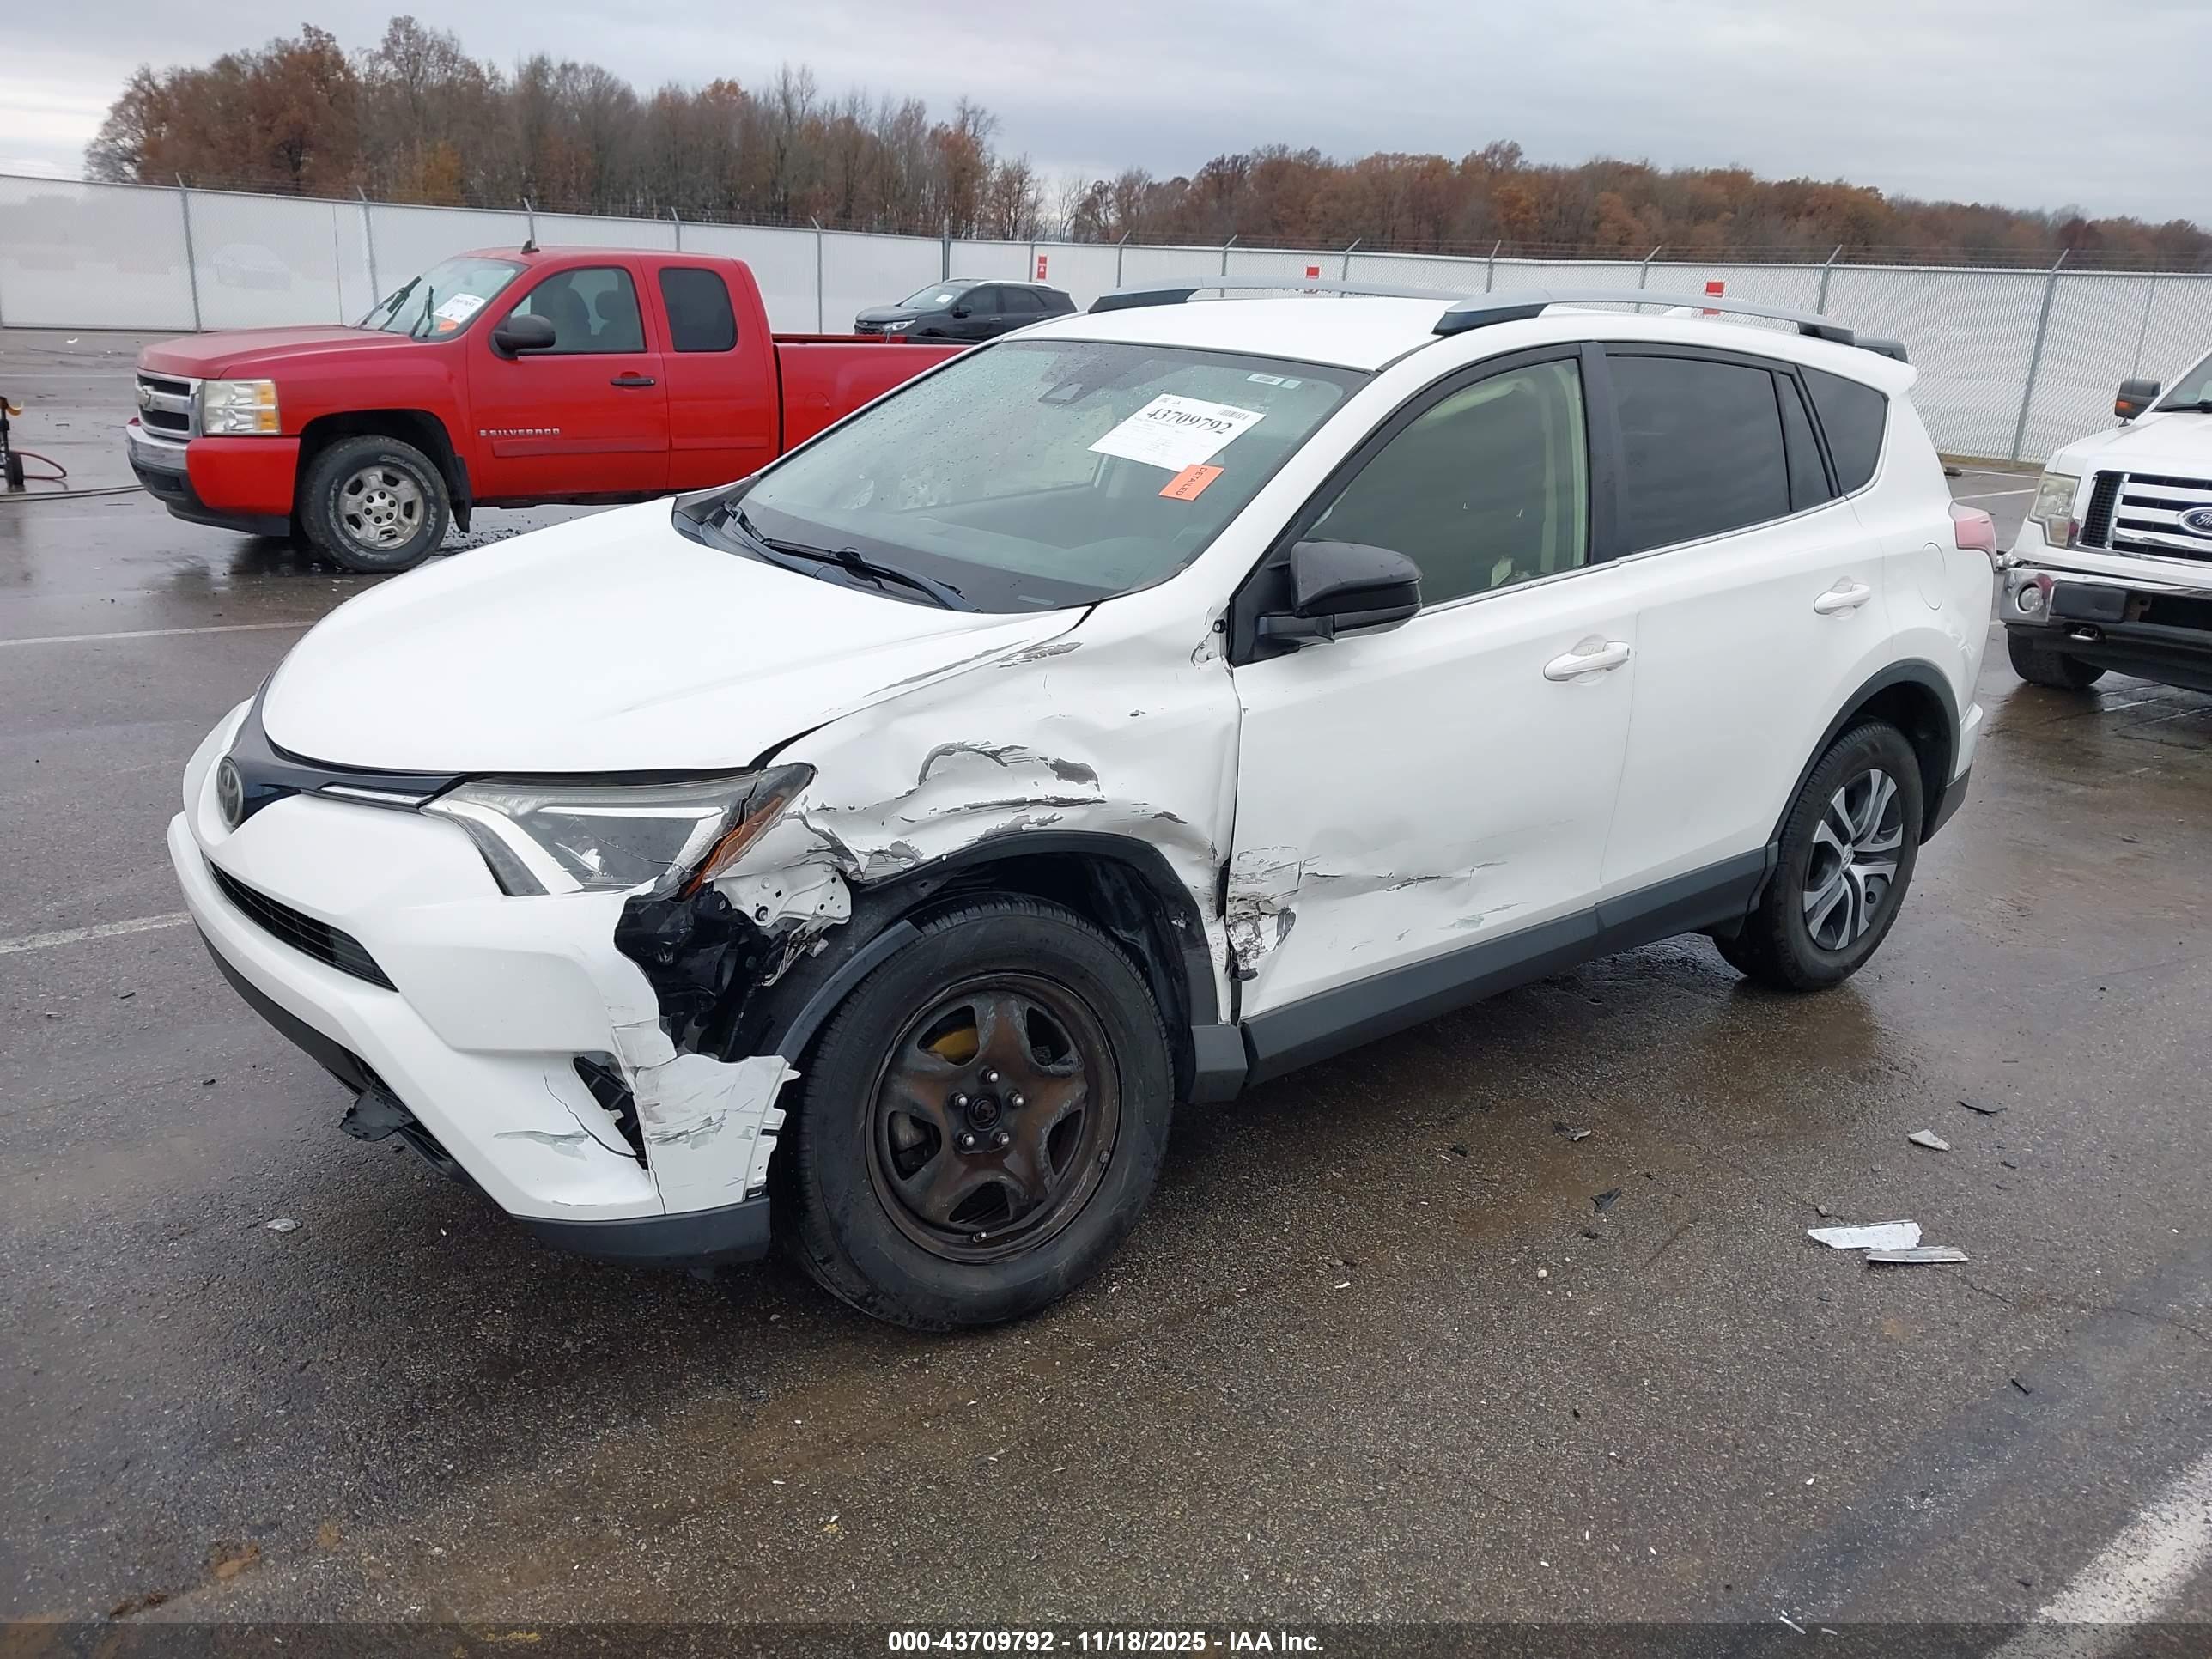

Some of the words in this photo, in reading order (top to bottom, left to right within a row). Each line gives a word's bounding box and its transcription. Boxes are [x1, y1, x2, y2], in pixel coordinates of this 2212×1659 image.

[489, 428, 560, 437] SILVERADO
[1146, 408, 1233, 434] 43709792
[1176, 467, 1208, 495] DETAILED
